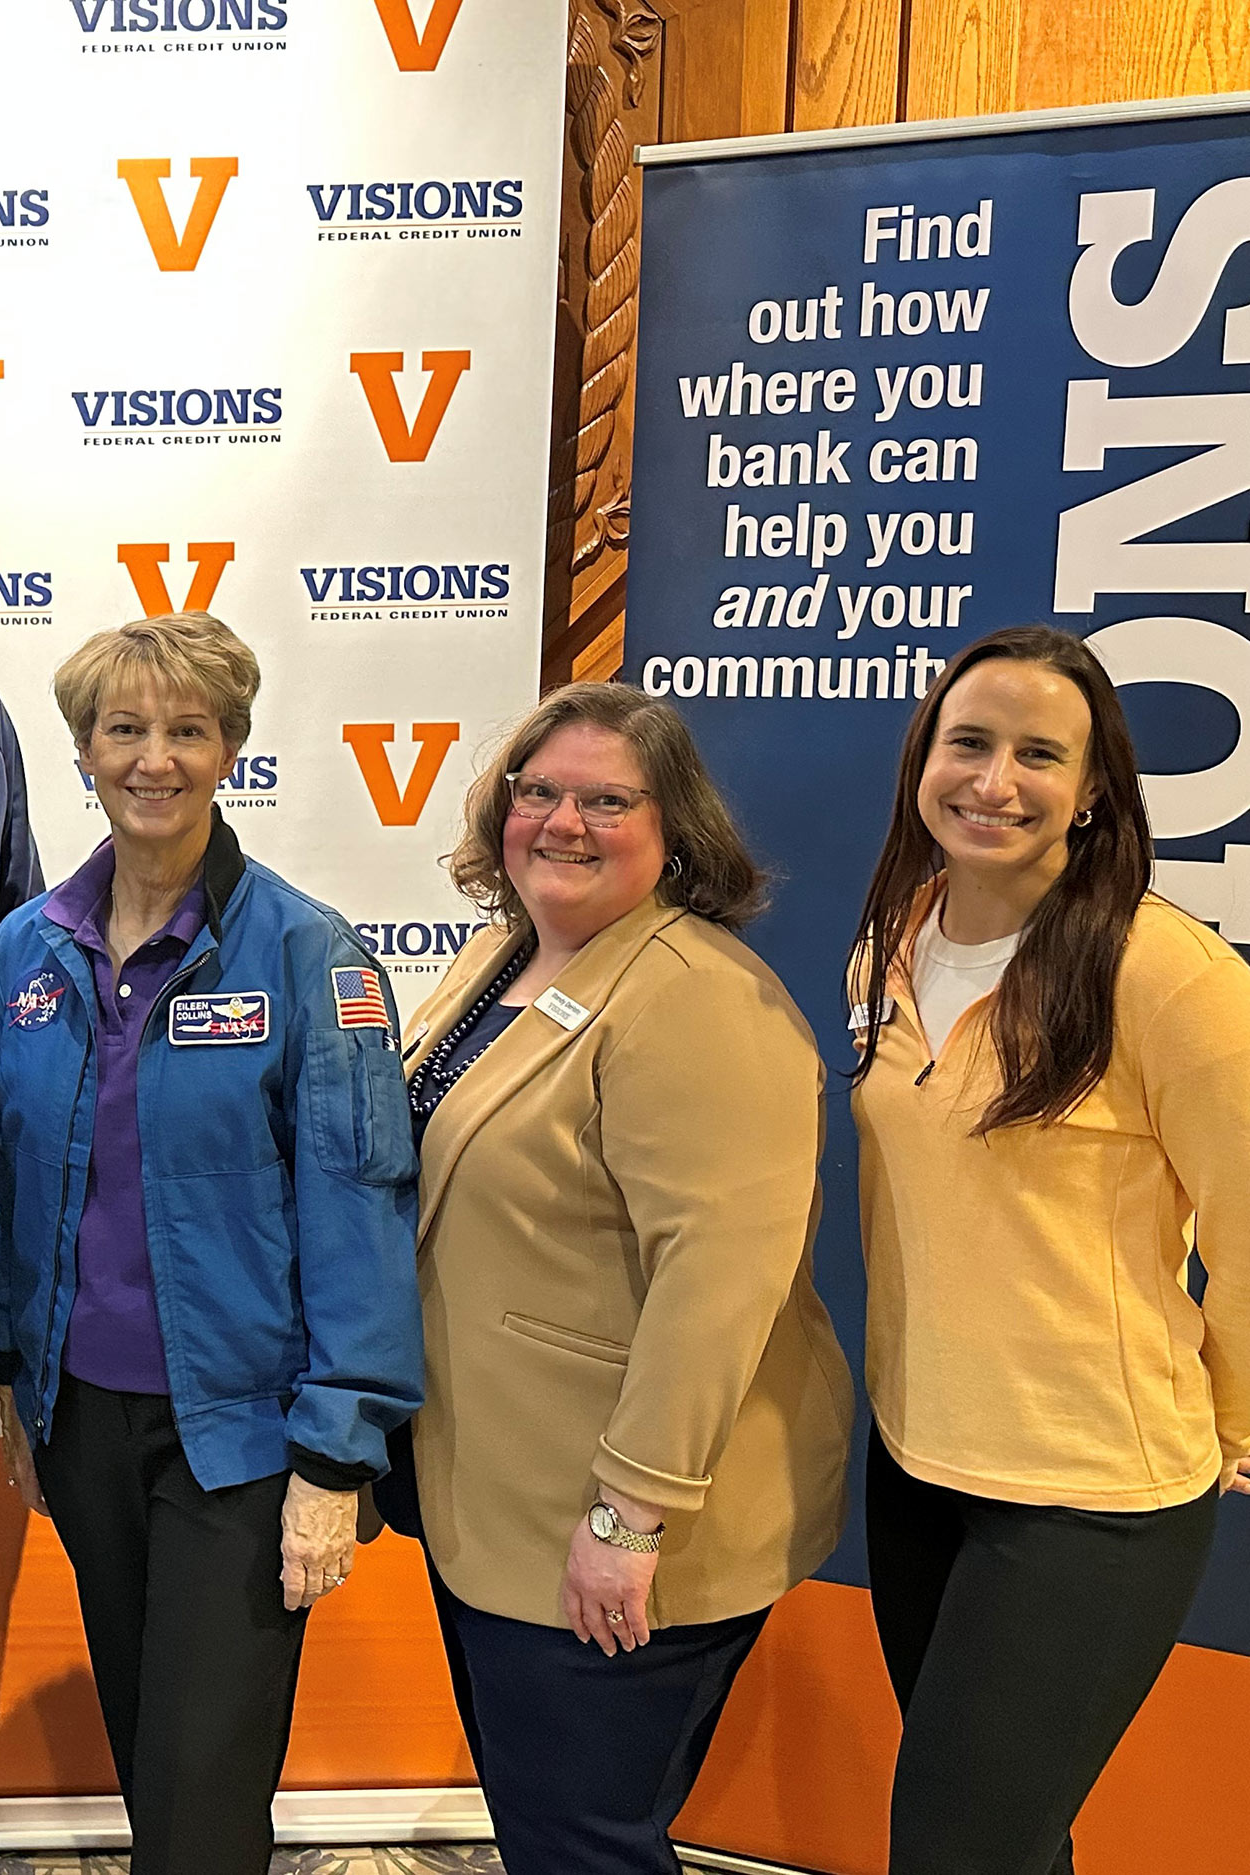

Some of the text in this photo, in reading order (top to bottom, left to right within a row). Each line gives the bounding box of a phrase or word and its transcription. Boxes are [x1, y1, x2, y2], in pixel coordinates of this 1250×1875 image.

[72, 0, 288, 33] VISIONS
[373, 0, 463, 72] V
[82, 40, 287, 54] FEDERAL CREDIT UNION
[117, 156, 239, 272] V
[306, 180, 523, 221] VISIONS
[317, 228, 521, 242] FEDERAL CREDIT UNION
[863, 199, 993, 264] Find
[748, 282, 991, 344] out how
[71, 387, 283, 427] VISIONS
[349, 349, 471, 463] V
[678, 362, 983, 421] where you
[83, 433, 282, 447] FEDERAL CREDIT UNION
[707, 430, 978, 488] bank can
[724, 502, 974, 569] help you
[300, 563, 510, 603] VISIONS
[0, 616, 52, 626] UNION
[311, 608, 509, 621] FEDERAL CREDIT UNION
[713, 573, 973, 640] and your
[642, 645, 946, 700] communit
[342, 722, 461, 827] V
[225, 798, 277, 808] UNION
[353, 922, 489, 956] SION
[383, 965, 440, 974] CREDIT
[16, 992, 57, 1011] NASA
[176, 1002, 209, 1011] EILEEN
[176, 1010, 212, 1021] COLLINS
[220, 1020, 259, 1033] NASA
